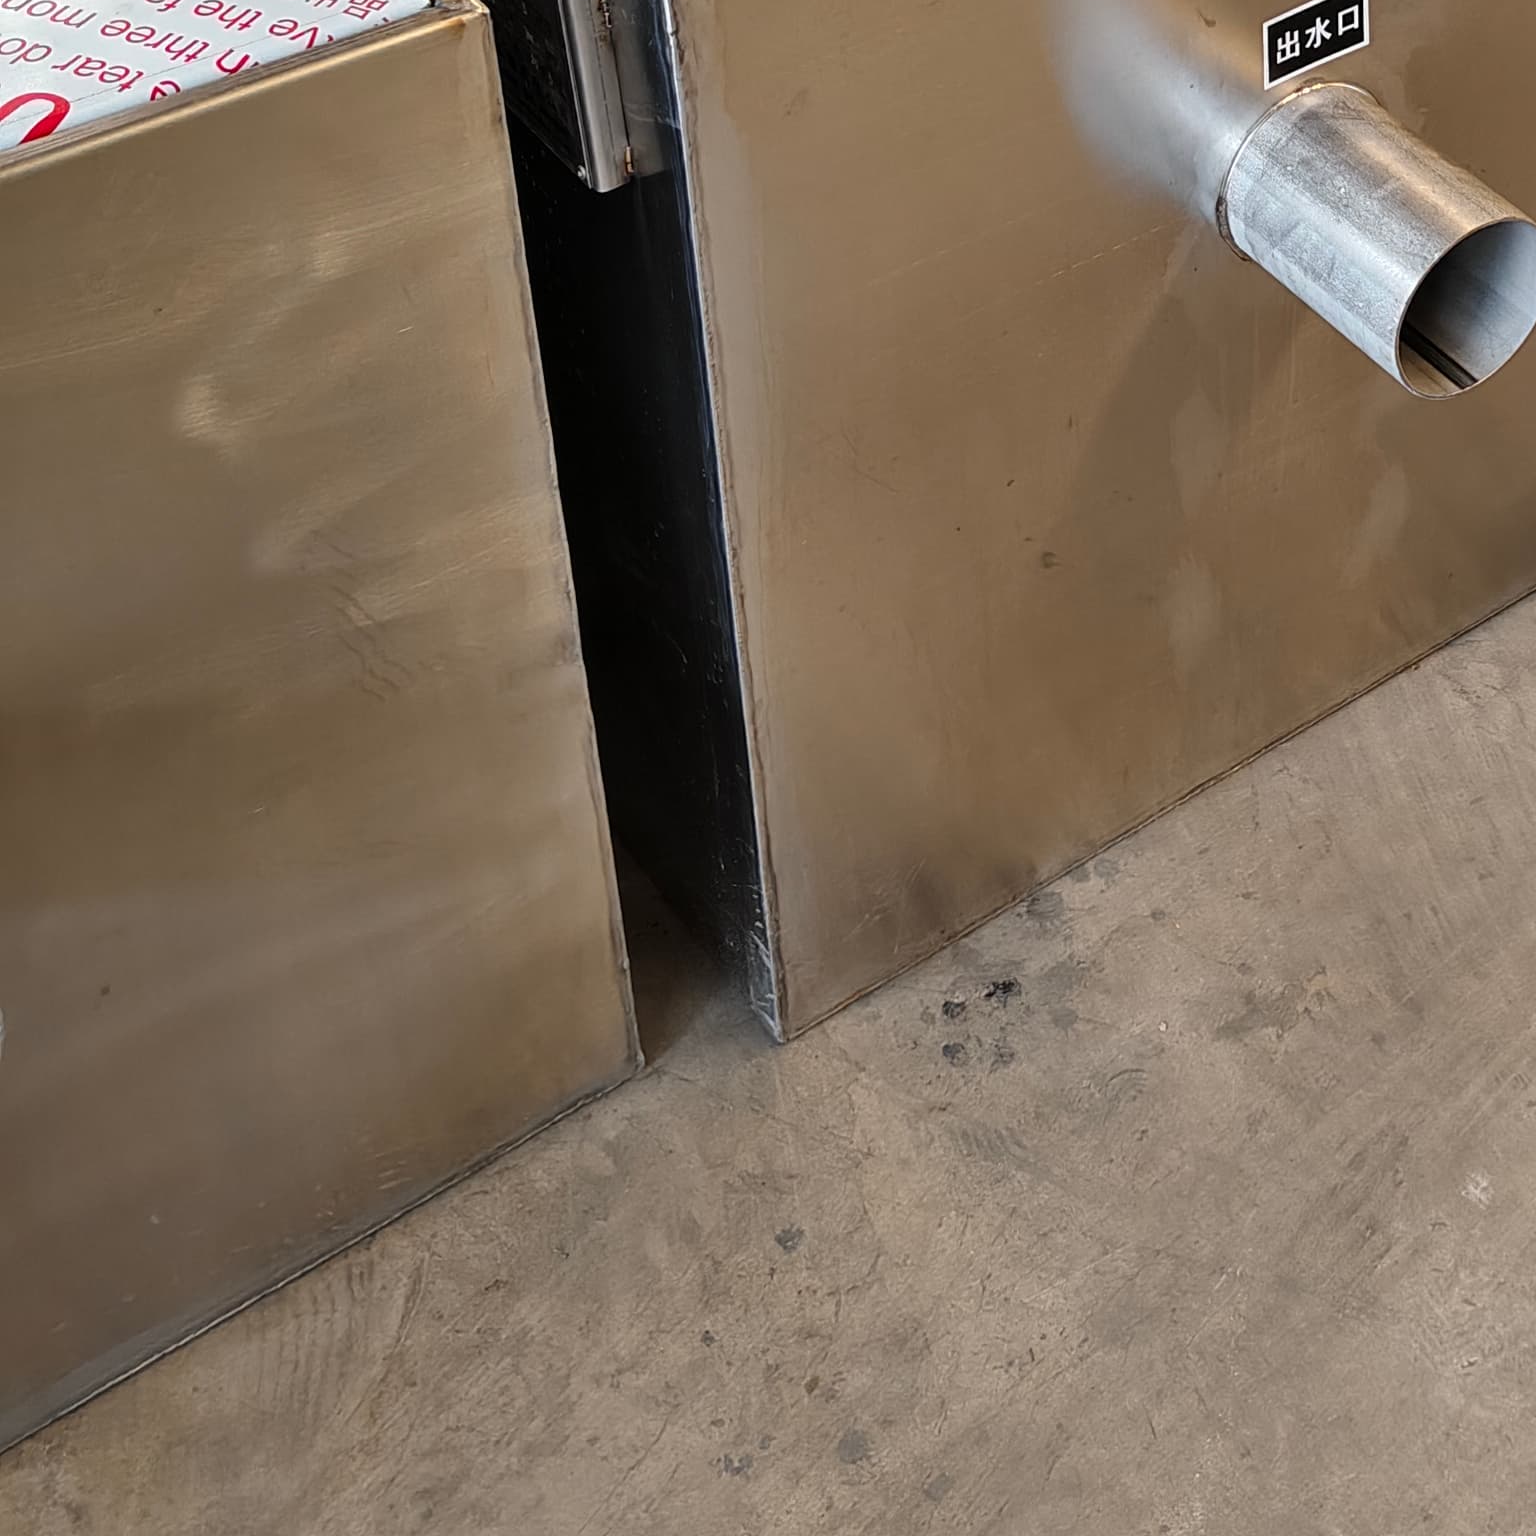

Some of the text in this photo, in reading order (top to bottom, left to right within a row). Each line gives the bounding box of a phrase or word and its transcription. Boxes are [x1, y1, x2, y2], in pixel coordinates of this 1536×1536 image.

[100, 15, 212, 65] three
[193, 0, 265, 34] the
[1276, 3, 1360, 65] 出水口
[51, 52, 145, 94] tear
